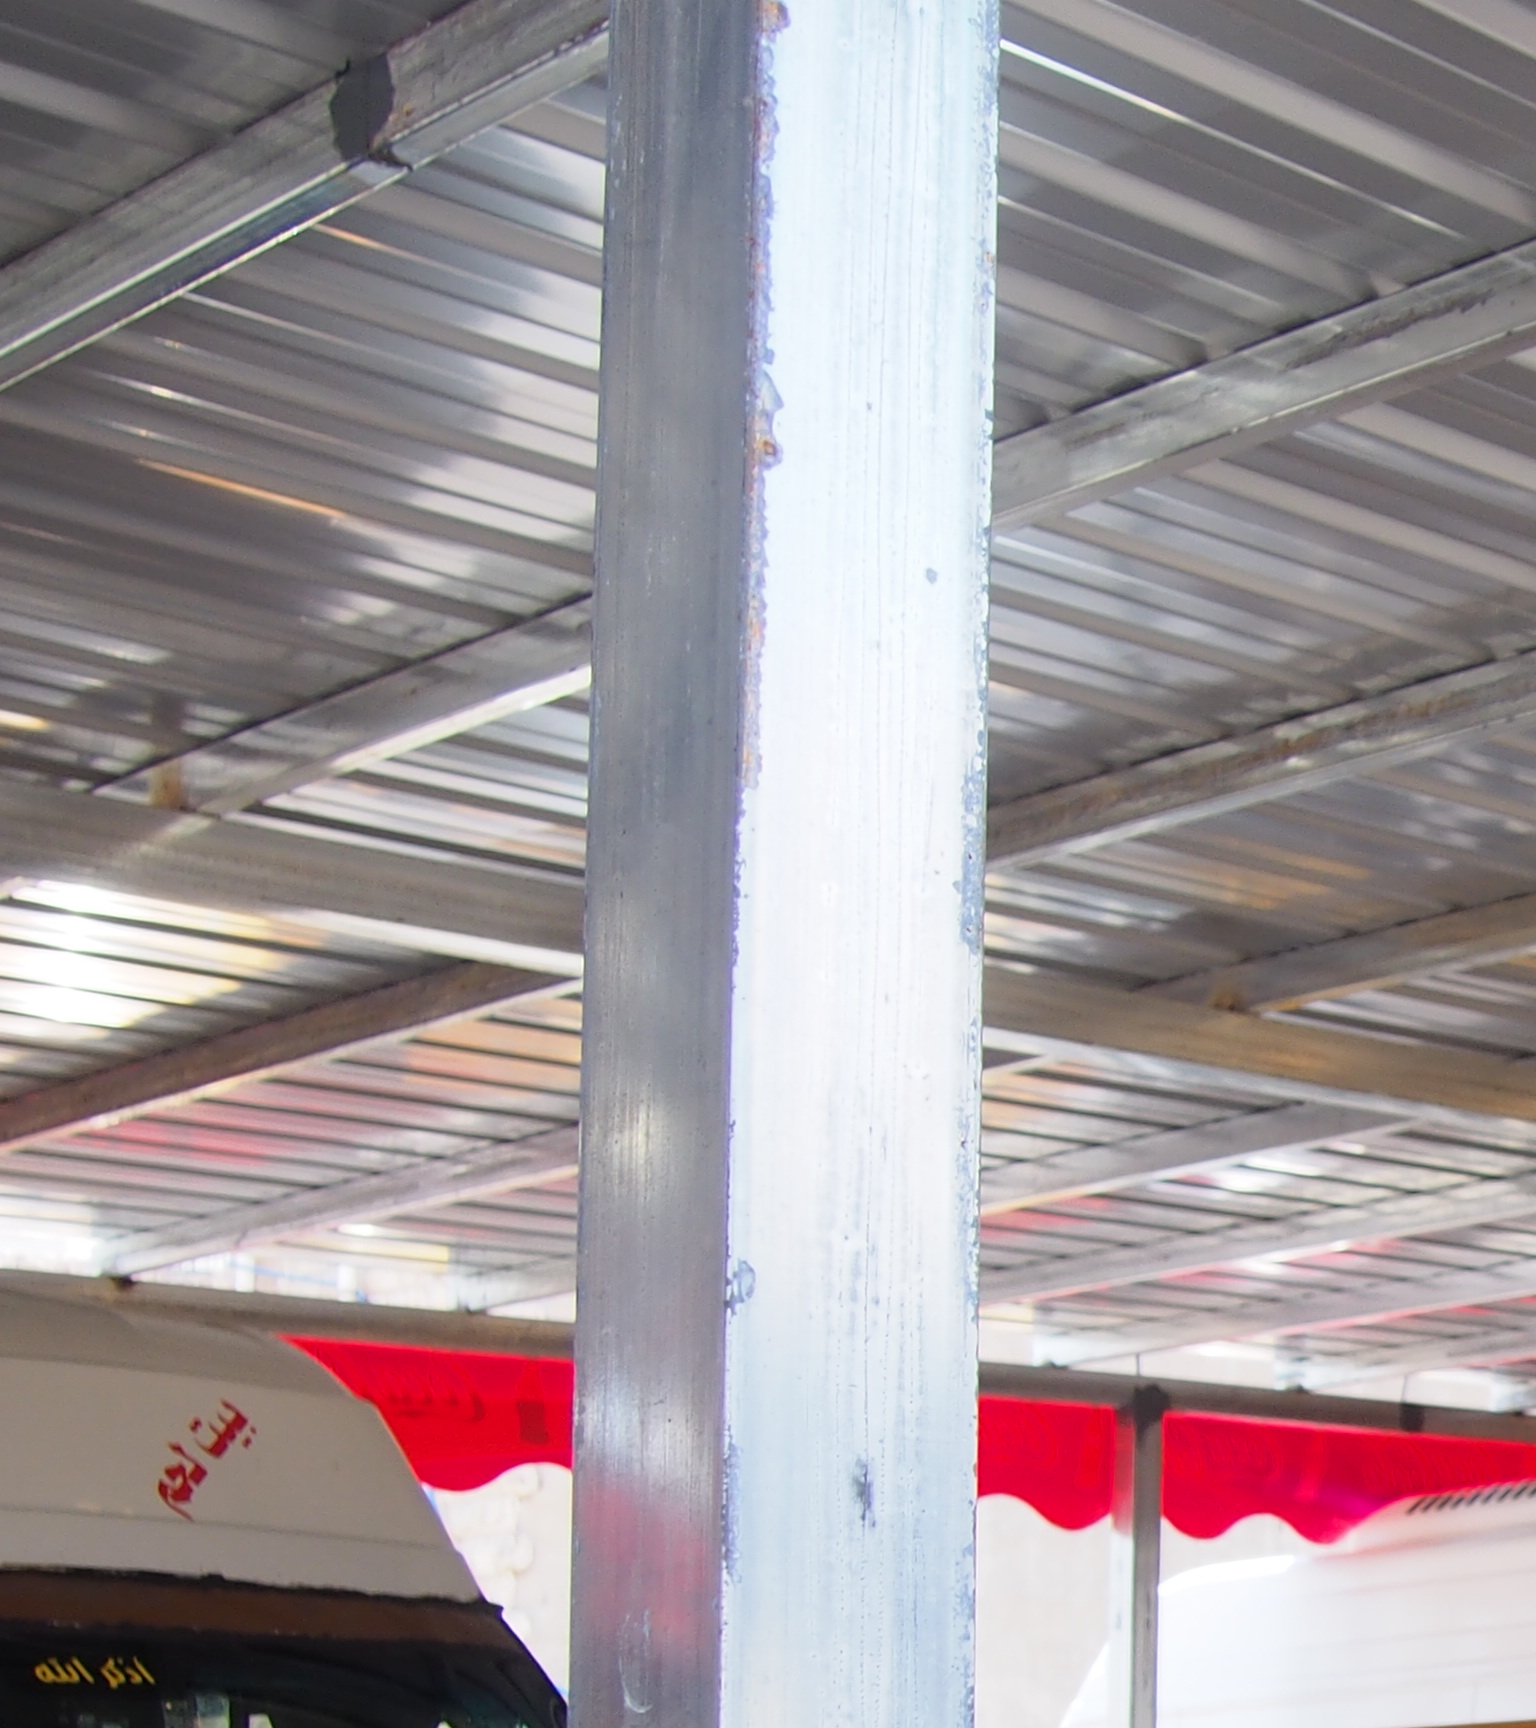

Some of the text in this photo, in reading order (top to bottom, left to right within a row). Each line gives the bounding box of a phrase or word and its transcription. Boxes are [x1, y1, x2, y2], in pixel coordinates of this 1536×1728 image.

[158, 1399, 257, 1522] بيت لحم
[35, 1656, 94, 1684] الله
